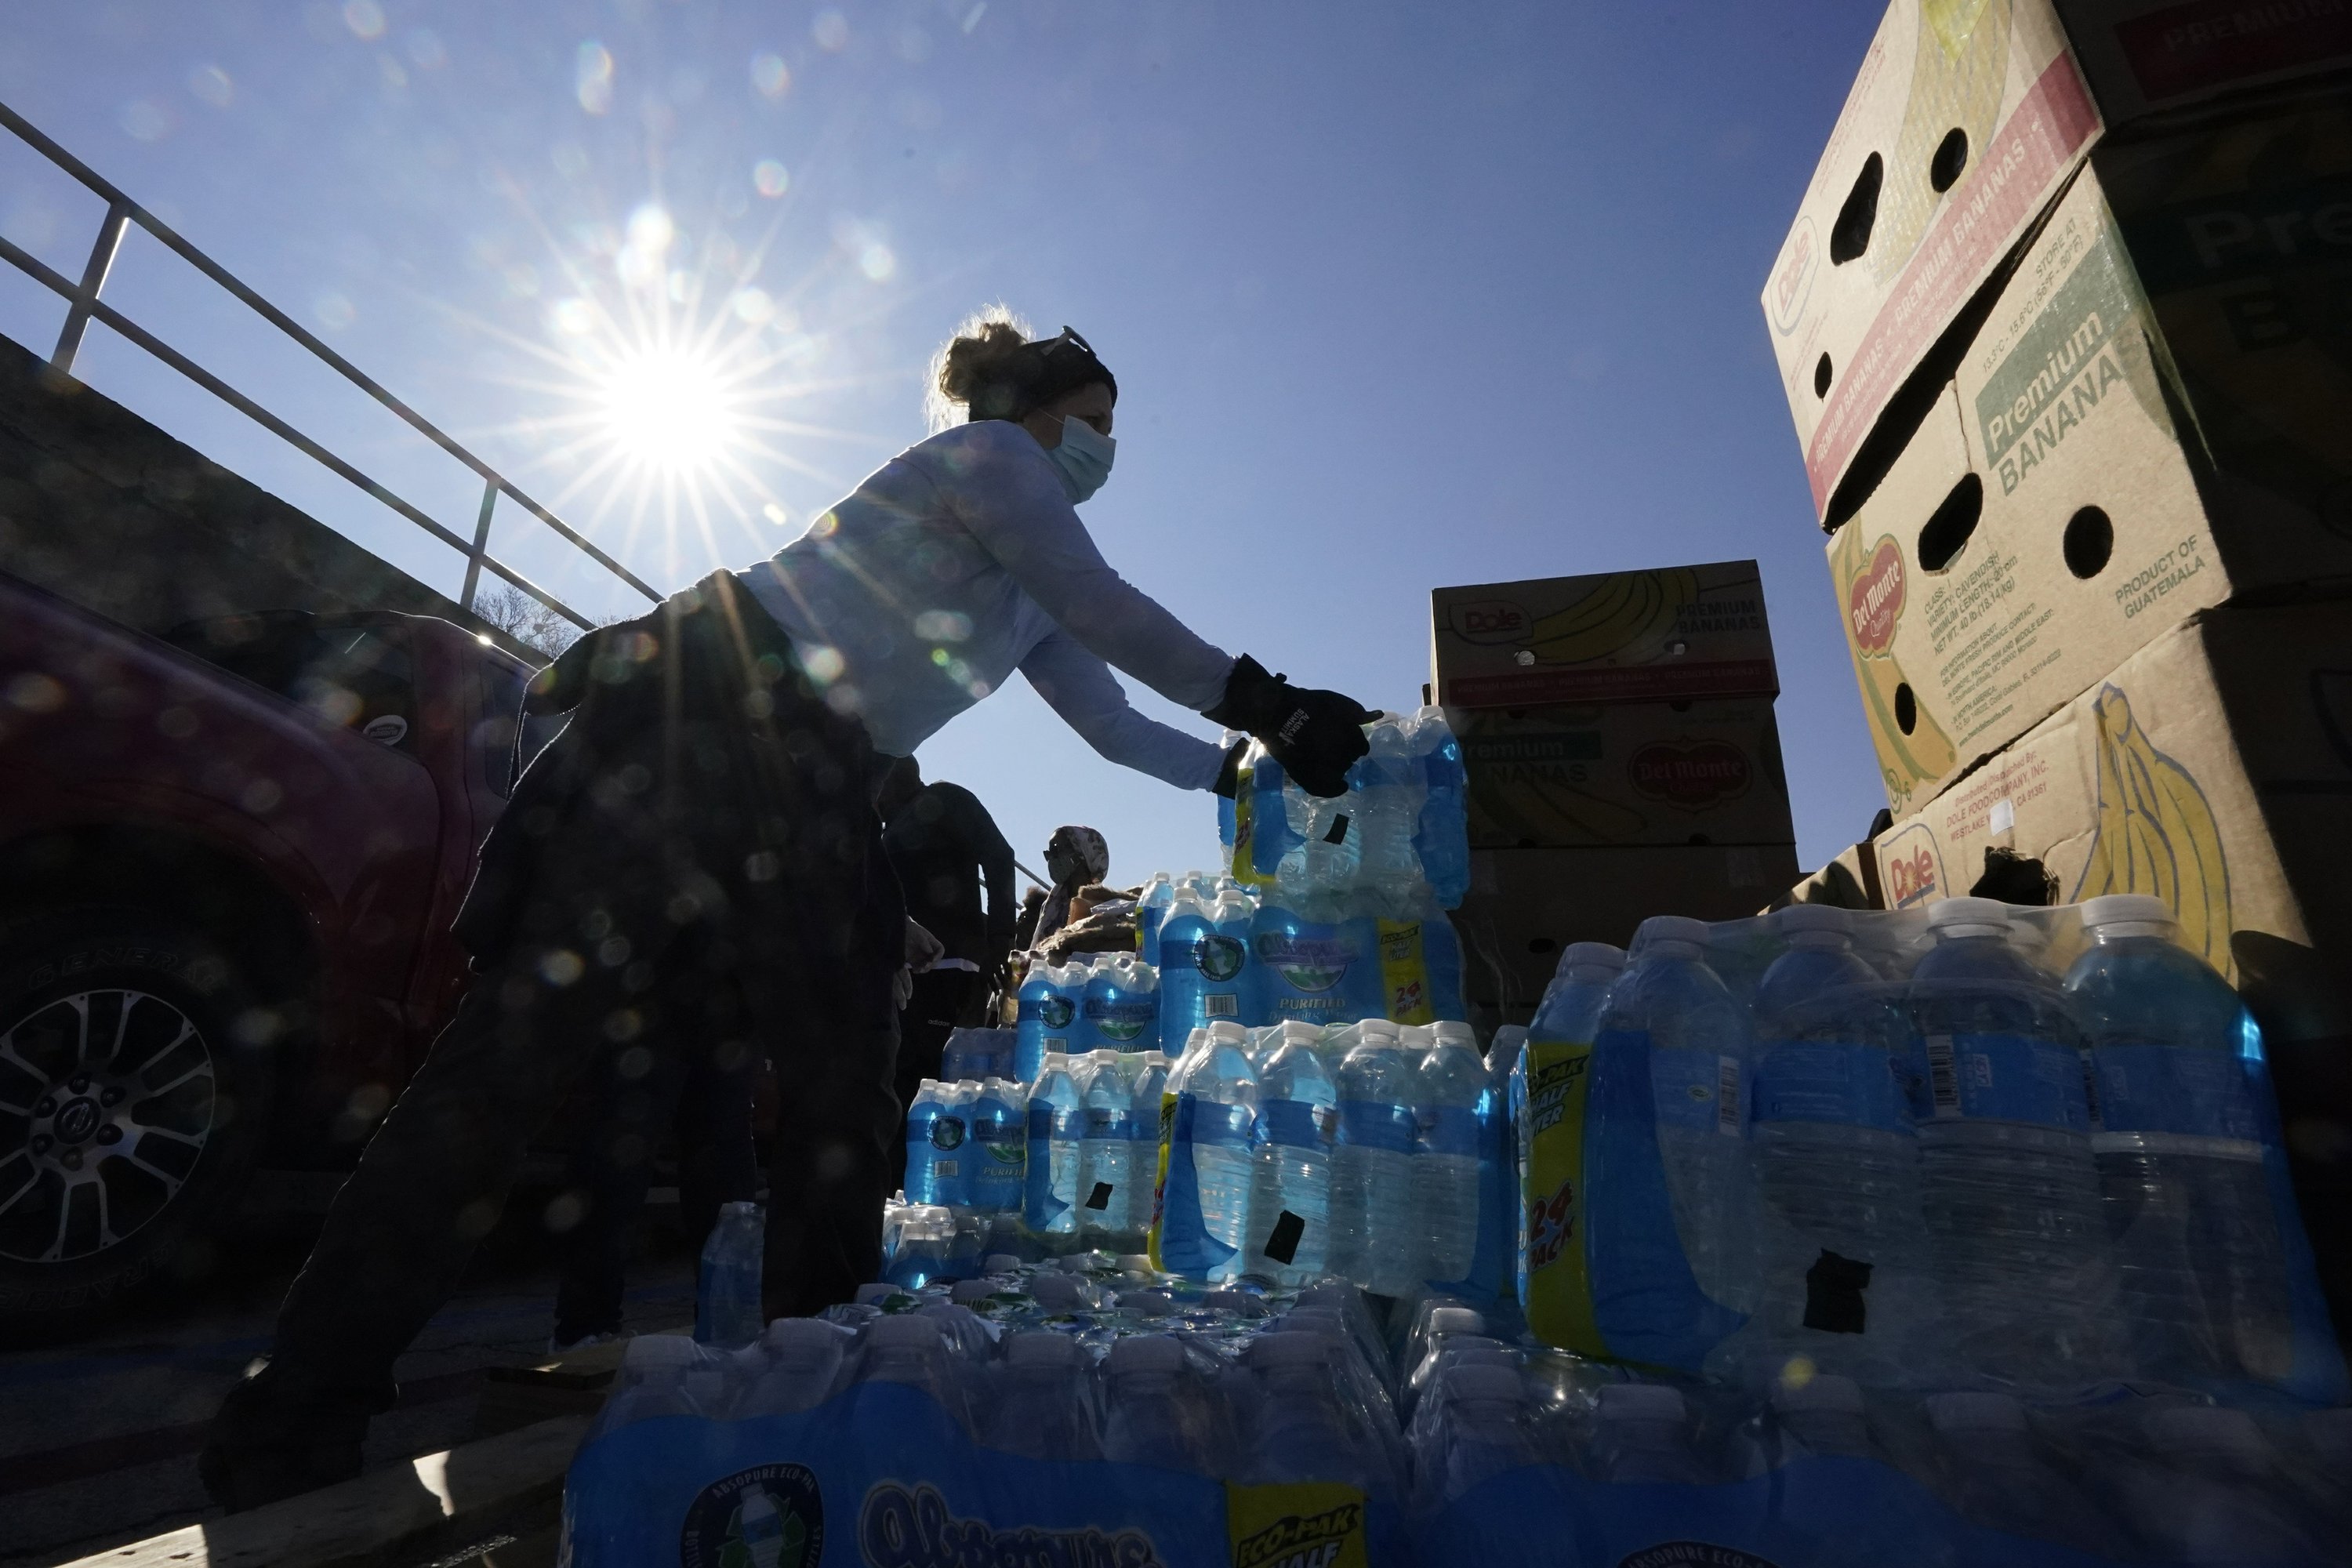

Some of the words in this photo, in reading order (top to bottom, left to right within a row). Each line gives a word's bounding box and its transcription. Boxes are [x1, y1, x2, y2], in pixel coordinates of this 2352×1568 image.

[1894, 236, 1954, 326] PREMIUM
[1951, 138, 2027, 246] BANANAS
[2035, 235, 2067, 278] STORE
[1843, 338, 1884, 412] BANANAS
[1987, 311, 2103, 453] Premium
[1927, 595, 1955, 627] VARIETY:
[1955, 550, 2001, 600] CAVENDISH
[2115, 550, 2174, 604] PRODUCT
[2178, 534, 2198, 558] OF
[2125, 555, 2206, 619] GUATEMALA
[1465, 608, 1523, 631] Dole
[1675, 599, 1757, 617] PREMIUM
[1853, 597, 1871, 635] Del
[1867, 560, 1900, 615] Monte
[1925, 586, 1946, 615] CLASS:
[1930, 608, 1959, 642] MINIMUM
[1959, 579, 1994, 614] LENGTH:
[1934, 634, 1947, 656] NET
[1946, 626, 1960, 642] WT.
[1960, 615, 1969, 631] 40
[1969, 609, 1978, 624] lb
[2001, 575, 2016, 593] kg)
[1679, 615, 1762, 633] BANANAS
[1281, 708, 1305, 734] SUMMIT
[1287, 713, 1311, 737] ALASKA
[1639, 762, 1671, 781] Del
[1674, 759, 1743, 779] Monte
[1947, 808, 1966, 828] DOLE
[2031, 760, 2050, 779] INC.
[1950, 816, 1987, 842] WESTLAKE
[1891, 844, 1935, 902] Dole
[1279, 997, 1346, 1010] PURIFIED
[1396, 981, 1421, 1004] 24
[1530, 1180, 1573, 1242] 24
[711, 1467, 777, 1500] ABSOPURE
